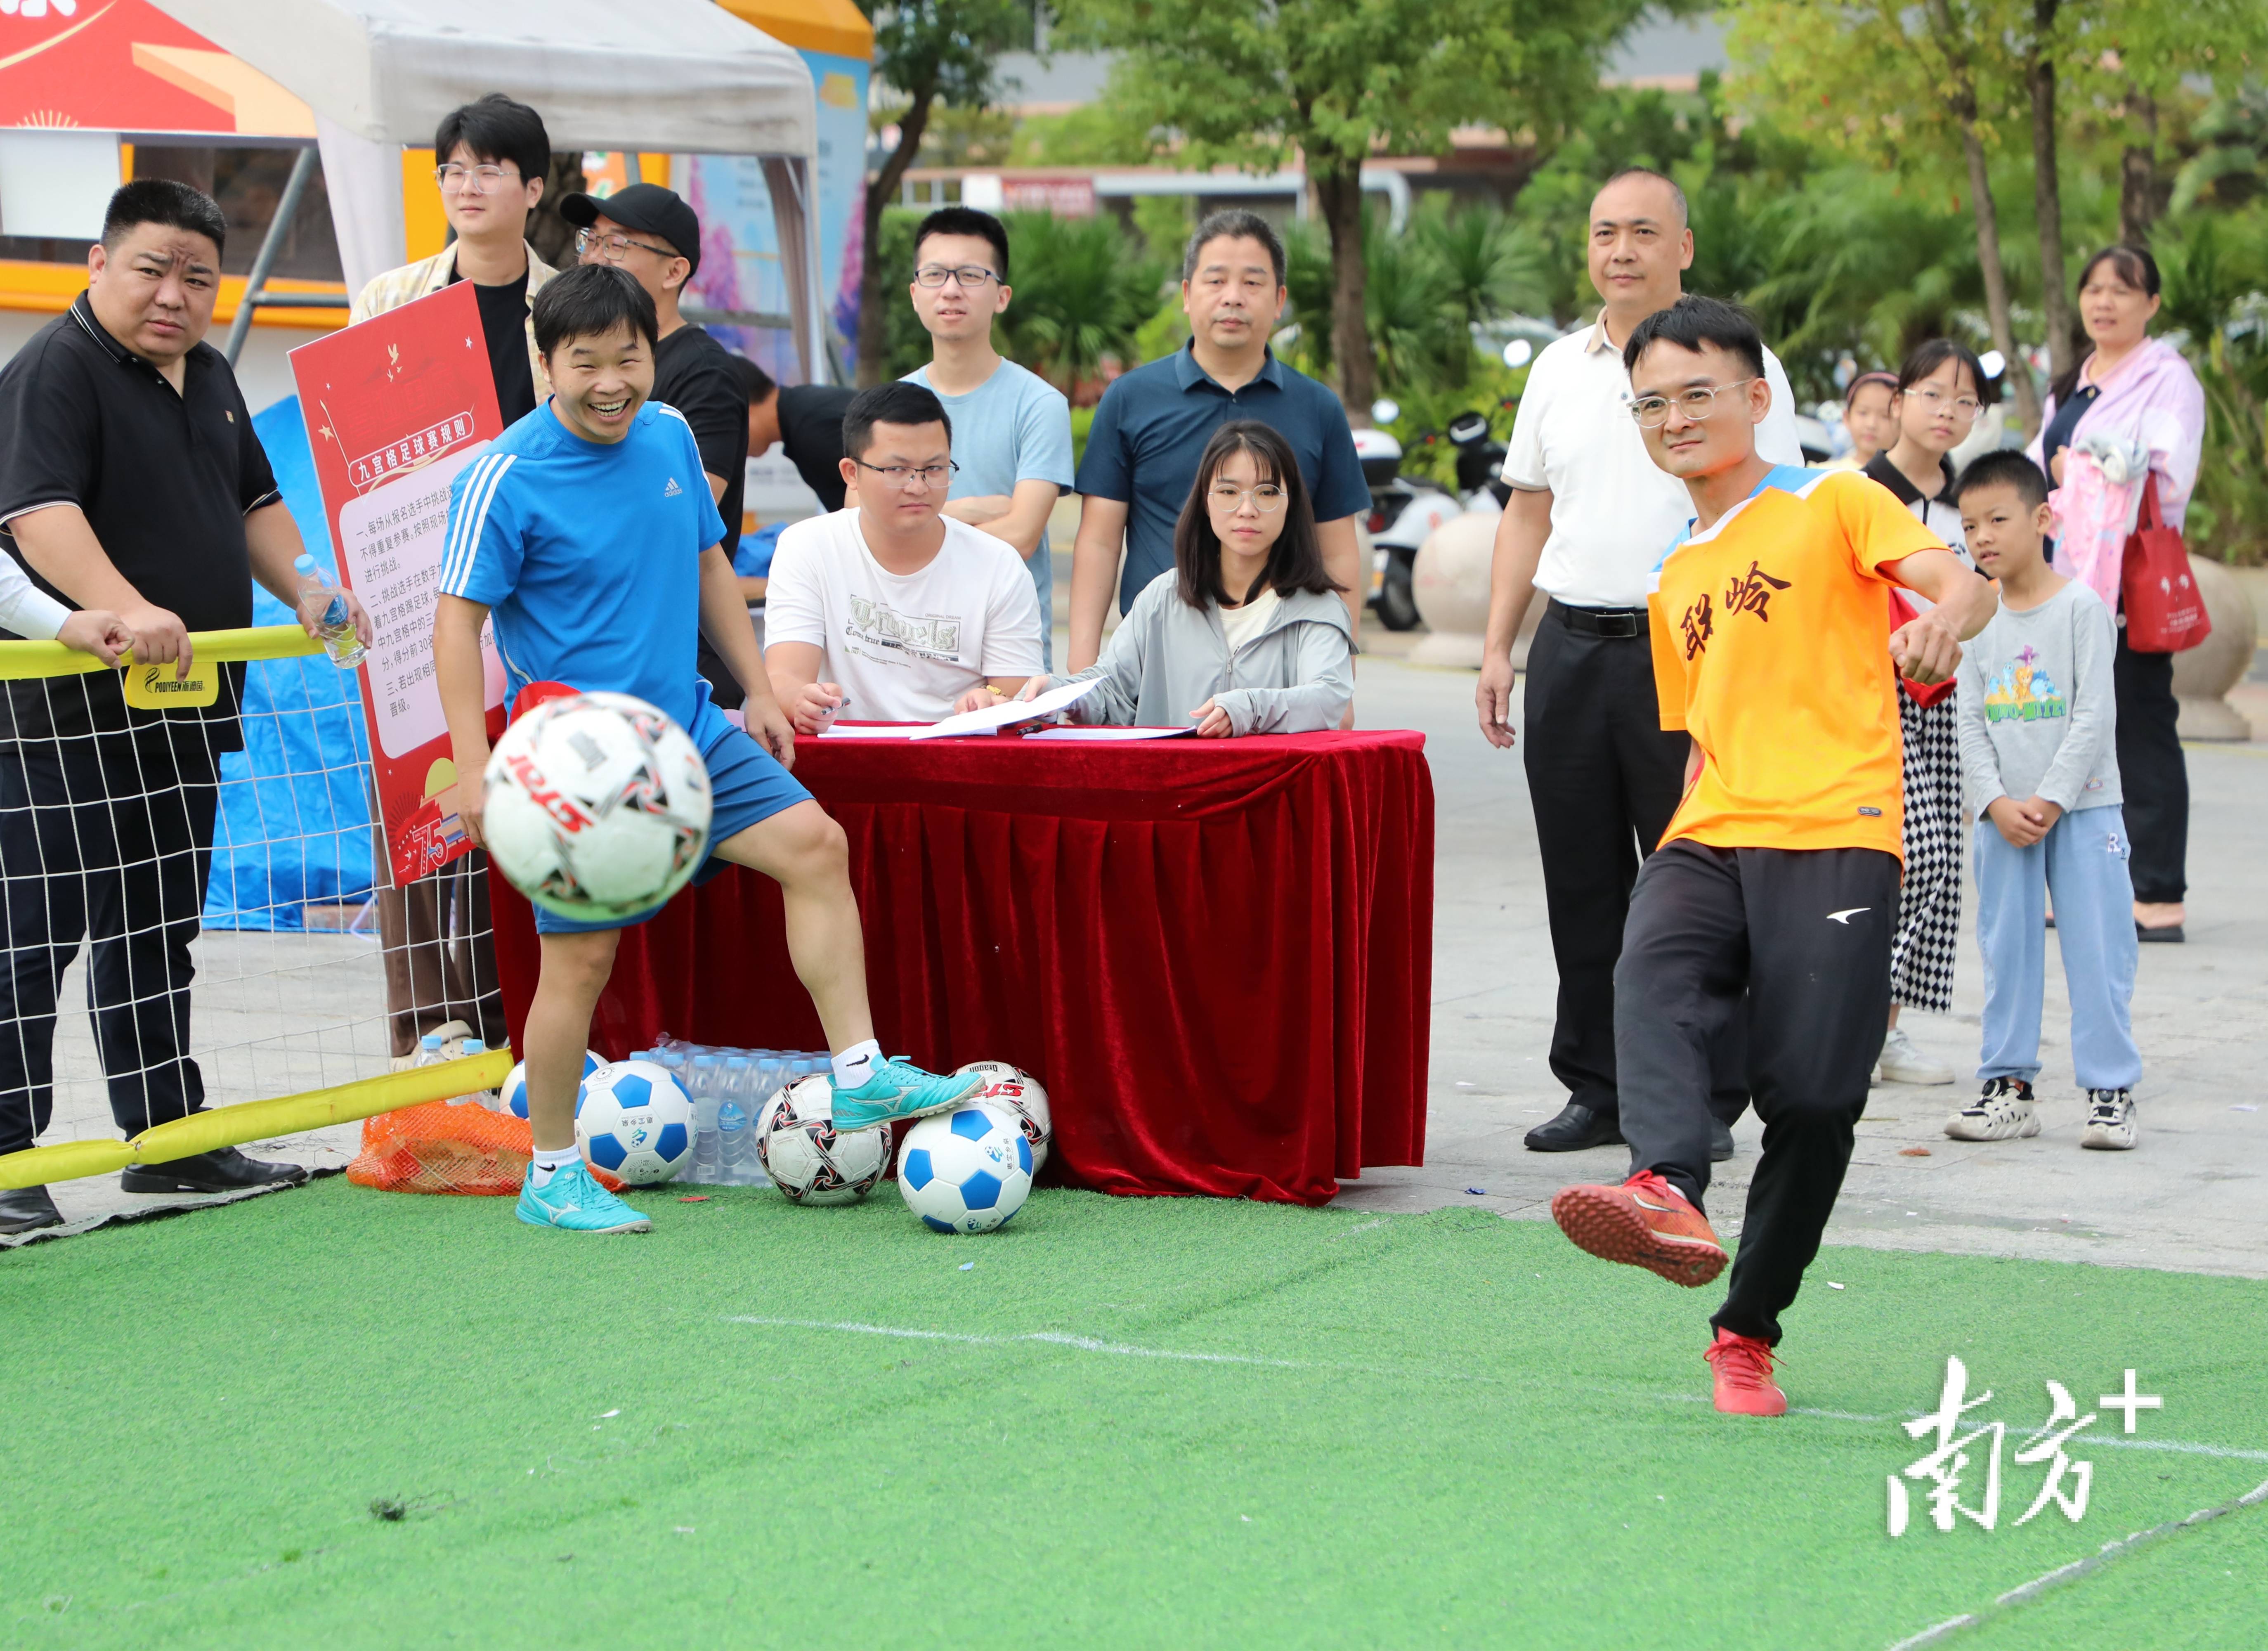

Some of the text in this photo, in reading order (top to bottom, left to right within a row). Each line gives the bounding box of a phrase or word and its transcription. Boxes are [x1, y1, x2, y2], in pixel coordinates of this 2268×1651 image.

[358, 417, 465, 481] 九宫格足球赛规则
[664, 488, 683, 497] adidas
[364, 557, 400, 584] 进行挑战。
[390, 698, 410, 717] 晋级。
[412, 818, 448, 877] 75
